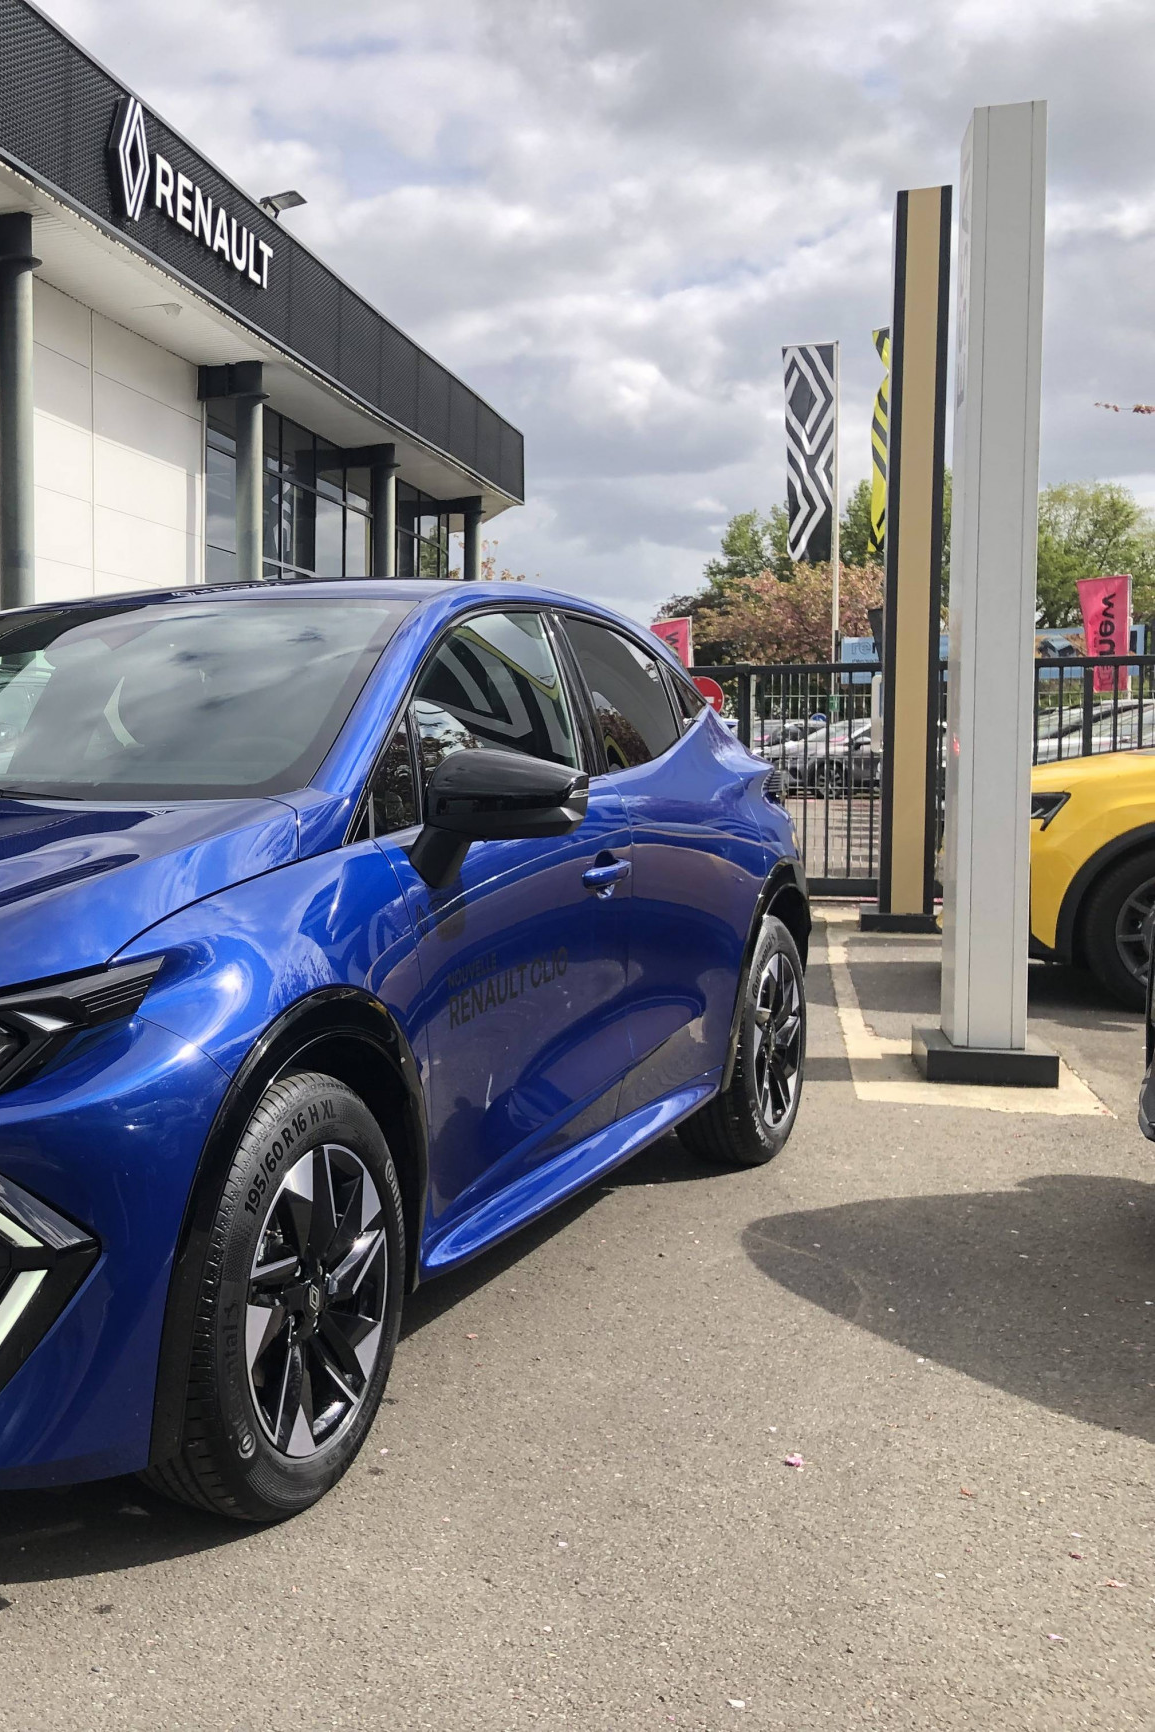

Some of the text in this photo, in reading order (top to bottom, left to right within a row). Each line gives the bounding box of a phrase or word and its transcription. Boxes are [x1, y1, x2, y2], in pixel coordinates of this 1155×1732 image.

[155, 153, 274, 289] RENAULT
[448, 945, 568, 1030] RENAULT CLIO
[244, 1141, 284, 1216] 195/60
[308, 1103, 320, 1125] H
[320, 1099, 337, 1120] XL
